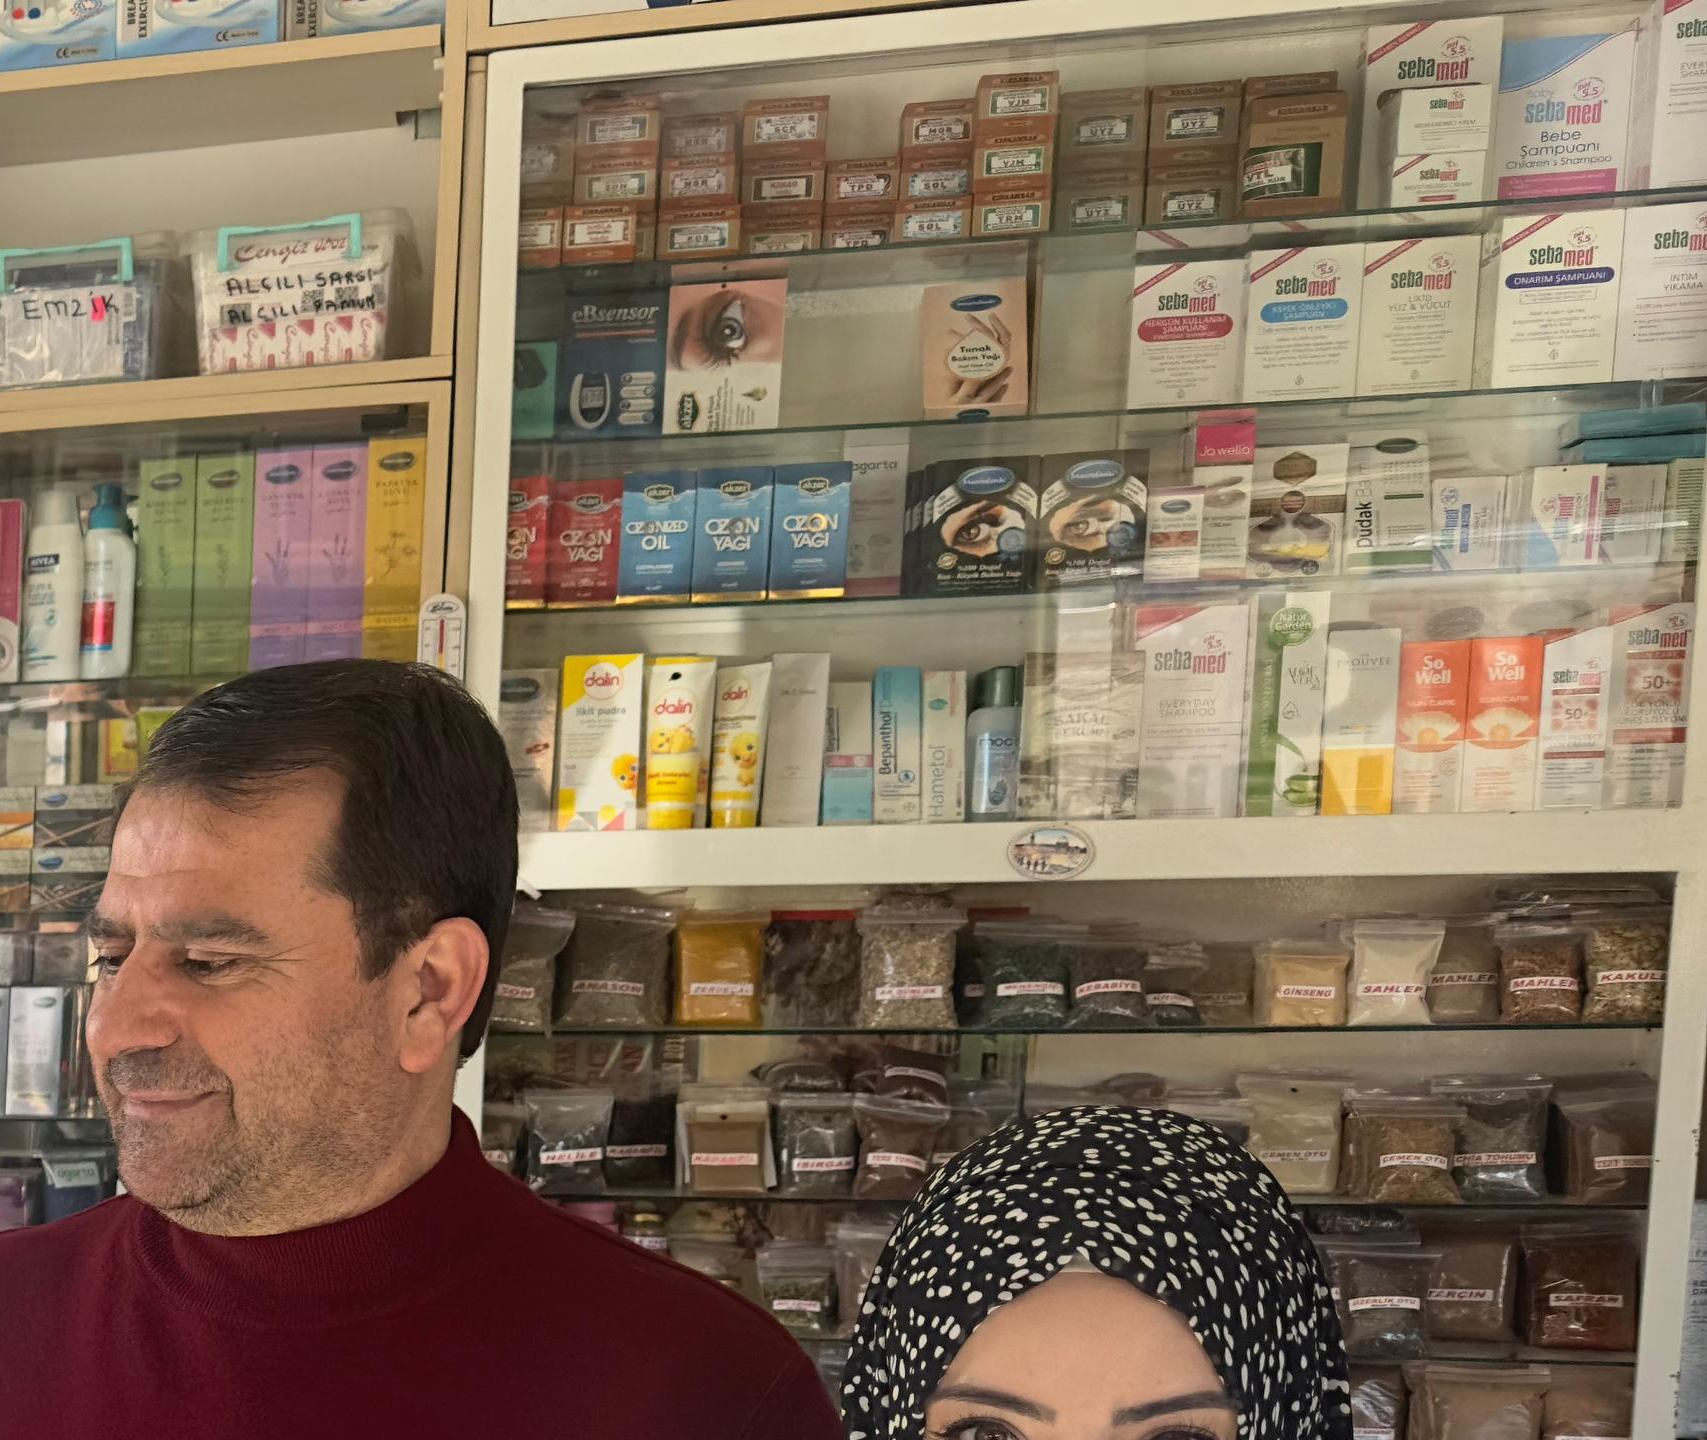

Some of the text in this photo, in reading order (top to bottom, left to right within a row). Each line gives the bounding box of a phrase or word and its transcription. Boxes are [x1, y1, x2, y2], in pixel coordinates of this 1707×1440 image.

[1397, 55, 1471, 82] sebamed
[1429, 98, 1465, 111] sebamed
[1524, 99, 1603, 126] sebamed
[1540, 129, 1582, 143] Bebe
[1519, 141, 1601, 159] Şampuanı
[1505, 154, 1613, 170] Children's Shampoo
[1419, 168, 1459, 182] sebamed
[1529, 245, 1595, 267] sebamed
[1390, 269, 1454, 291] sebamed
[1513, 270, 1606, 286] ONARIM ŞAMPUANI
[1275, 276, 1336, 297] sebamed
[1157, 292, 1217, 313] sebamed
[571, 304, 660, 323] eBsensor
[1181, 315, 1227, 326] KULLANIM
[1355, 501, 1373, 549] Dudak
[640, 535, 672, 552] OIL
[29, 556, 56, 569] NIVEA
[1277, 612, 1308, 623] Natur
[1273, 620, 1312, 633] Garden
[1627, 627, 1688, 649] sebamed
[1154, 648, 1228, 675] sebamed
[1421, 655, 1444, 671] So
[1496, 650, 1518, 667] So
[584, 671, 620, 689] dalin
[1414, 670, 1452, 686] Well
[1487, 665, 1526, 682] Well
[1552, 669, 1603, 686] sebamed
[1641, 675, 1674, 690] 50+
[721, 685, 748, 701] dalin
[597, 704, 627, 717] pudra
[654, 699, 693, 715] dalin
[878, 710, 895, 776] Bepanthol
[929, 744, 948, 818] Hametol
[574, 980, 642, 994] ANASON
[1282, 985, 1333, 998] GİNSENG
[1362, 983, 1424, 995] SAHLEP
[1512, 978, 1578, 990] MAHLEP
[1302, 1150, 1329, 1158] OTU
[1424, 1155, 1448, 1166] OTU
[1454, 1152, 1536, 1165] CHIA TOHUMU
